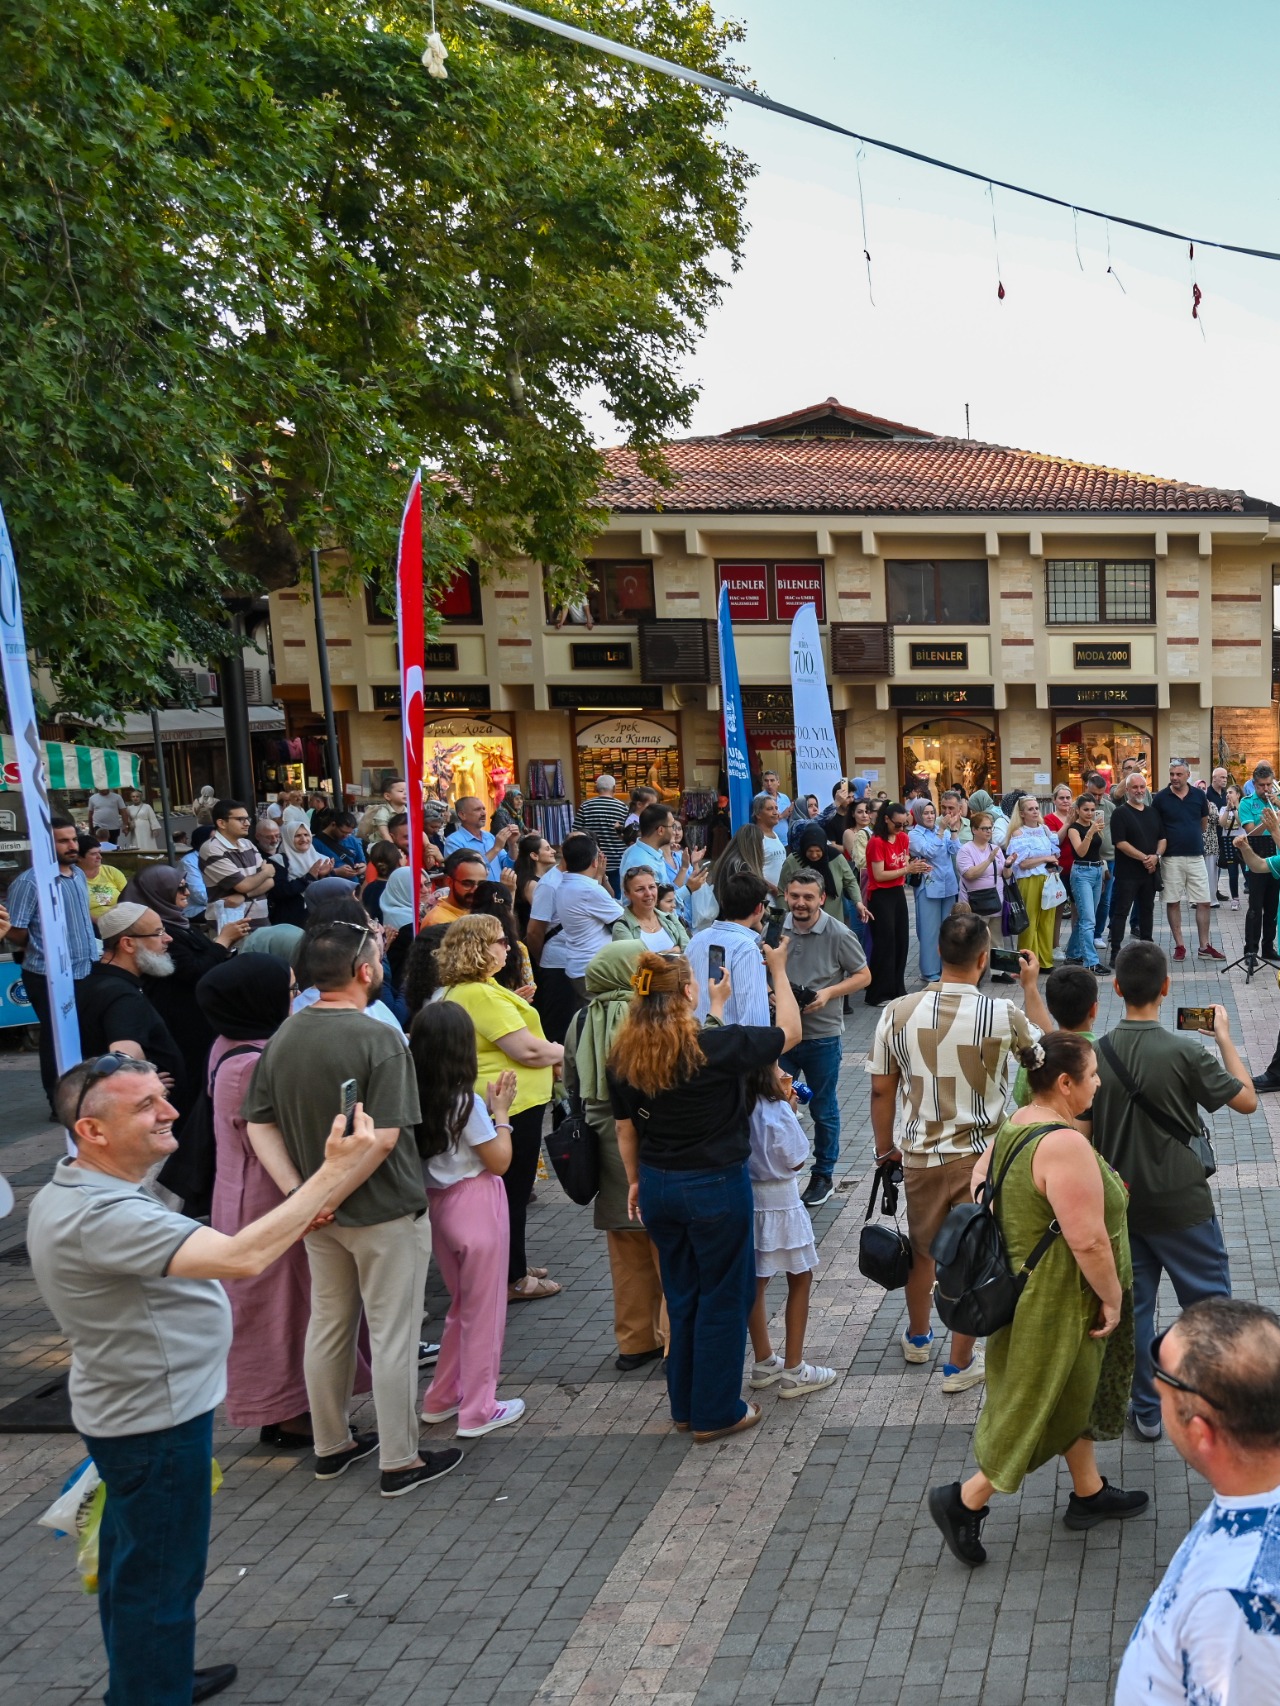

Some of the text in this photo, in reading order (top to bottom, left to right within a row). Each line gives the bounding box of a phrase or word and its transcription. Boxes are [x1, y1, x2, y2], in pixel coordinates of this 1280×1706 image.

[915, 649, 963, 661] BİLENLER
[1077, 651, 1128, 661] MODA 2000
[594, 733, 661, 745] Koza Kumaş
[811, 727, 833, 741] YIL
[796, 745, 836, 759] EYDAN
